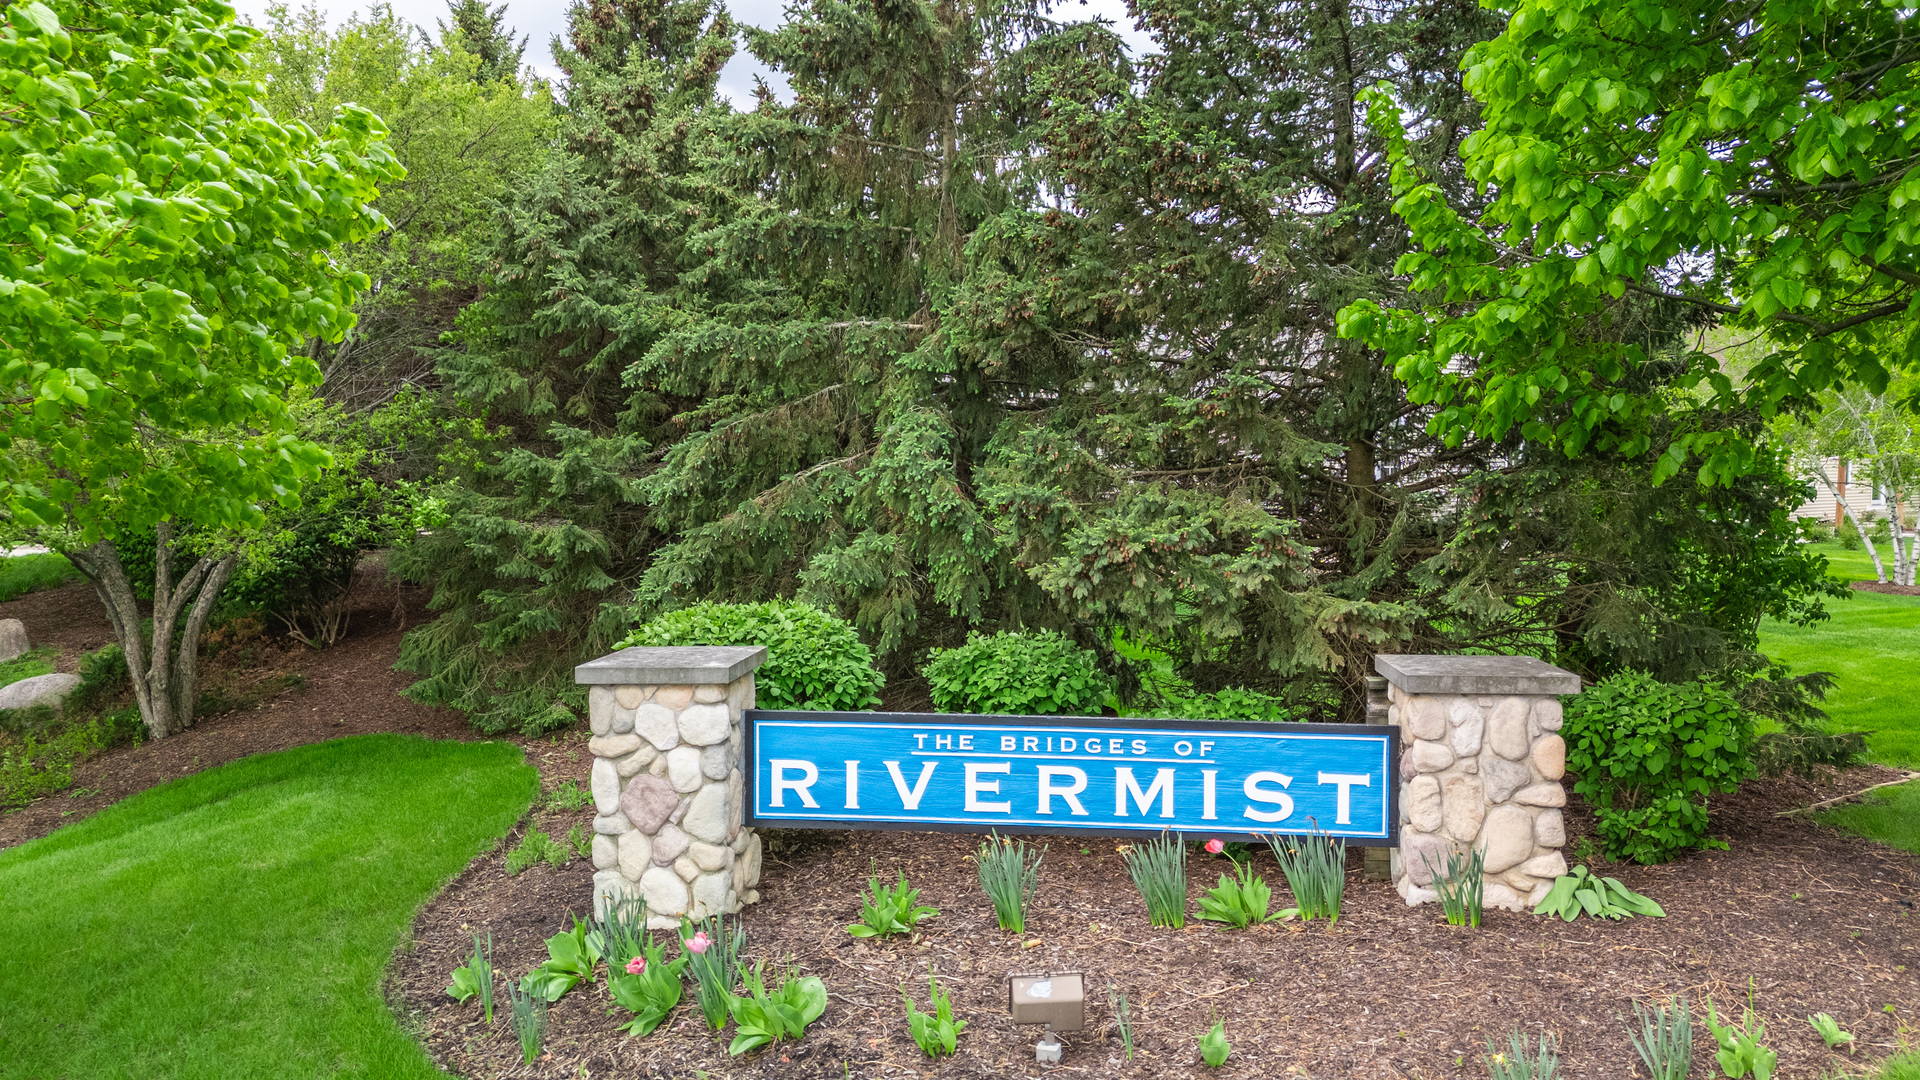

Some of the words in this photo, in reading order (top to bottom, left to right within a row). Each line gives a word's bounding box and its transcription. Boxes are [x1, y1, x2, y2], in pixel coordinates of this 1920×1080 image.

[912, 733, 975, 751] THE
[1000, 735, 1148, 755] BRIDGES
[1174, 740, 1217, 757] OF
[768, 758, 1372, 825] RIVERMIST
